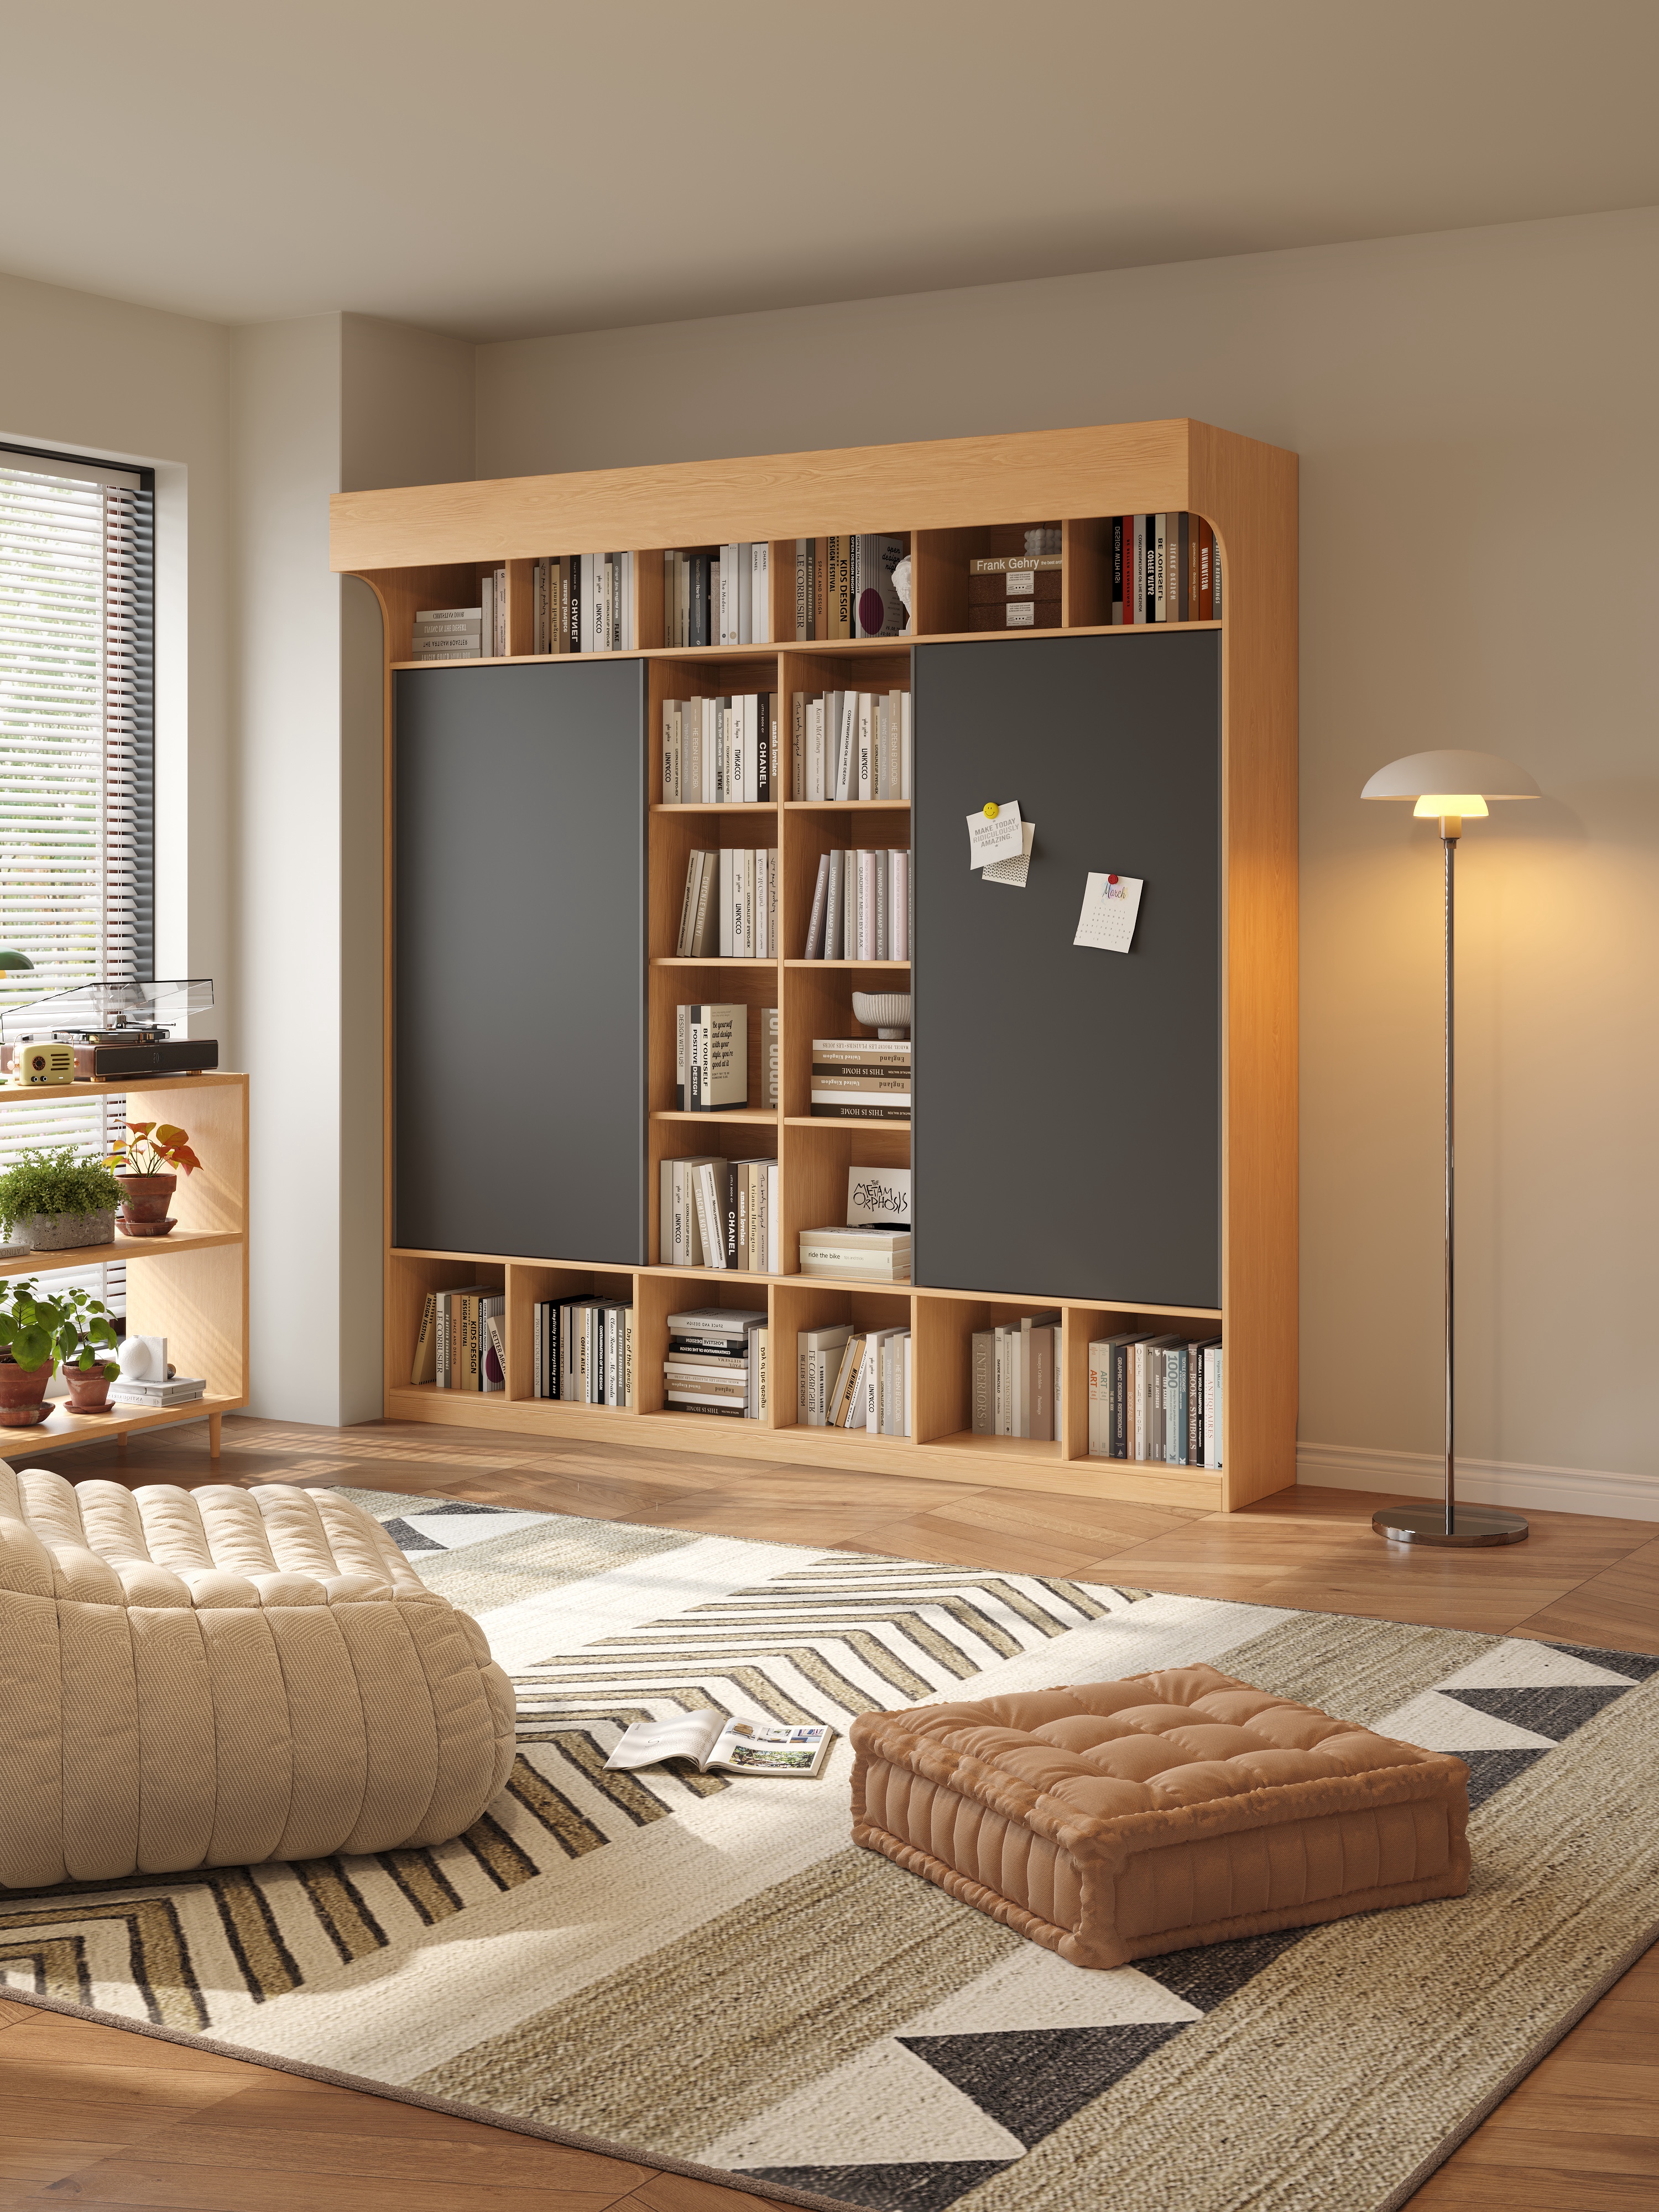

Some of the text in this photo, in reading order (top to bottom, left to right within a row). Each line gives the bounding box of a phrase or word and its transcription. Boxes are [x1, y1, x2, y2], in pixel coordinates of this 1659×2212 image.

[797, 554, 804, 566] LE
[977, 560, 1005, 571] Frank
[1009, 558, 1039, 570] Gehry
[973, 824, 1019, 843] RIDICULOUSLY
[975, 818, 1016, 836] MAKE TODAY
[981, 835, 1013, 848] AMAZING.
[816, 871, 825, 901] MATERIAL
[1102, 883, 1126, 899] March
[811, 926, 816, 935] BY
[878, 930, 882, 938] BY
[718, 1020, 733, 1030] yourself
[703, 1029, 707, 1039] BE
[720, 1031, 732, 1039] design
[712, 1061, 721, 1070] good
[696, 1189, 709, 1248] СПАСИТЕ КОТИКА!
[437, 1311, 442, 1321] LE
[492, 1330, 502, 1353] BETTER
[627, 1344, 632, 1353] of
[1168, 1355, 1178, 1389] 1000
[845, 1368, 857, 1400] MINIMALISM
[977, 1352, 986, 1420] INTERIORS
